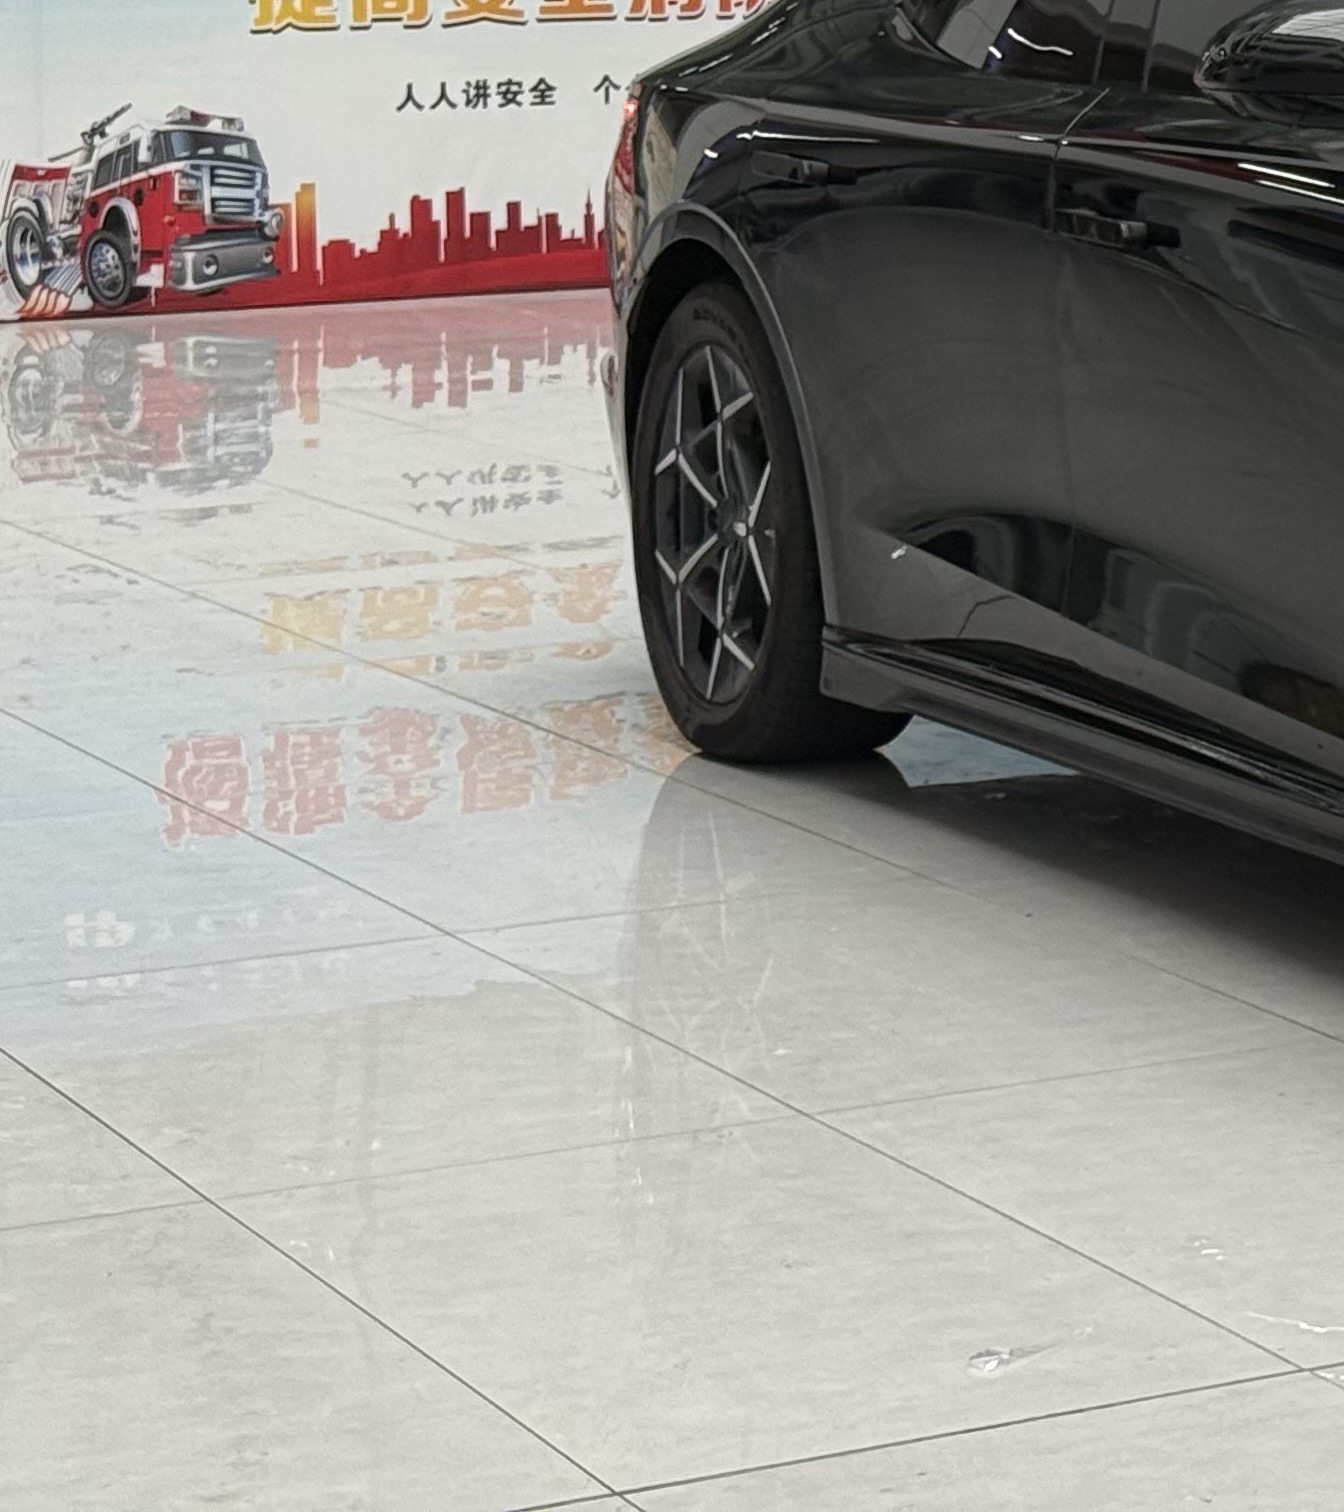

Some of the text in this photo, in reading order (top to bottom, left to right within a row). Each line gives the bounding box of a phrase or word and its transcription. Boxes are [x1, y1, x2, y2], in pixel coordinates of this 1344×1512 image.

[396, 77, 558, 113] 人人讲安全
